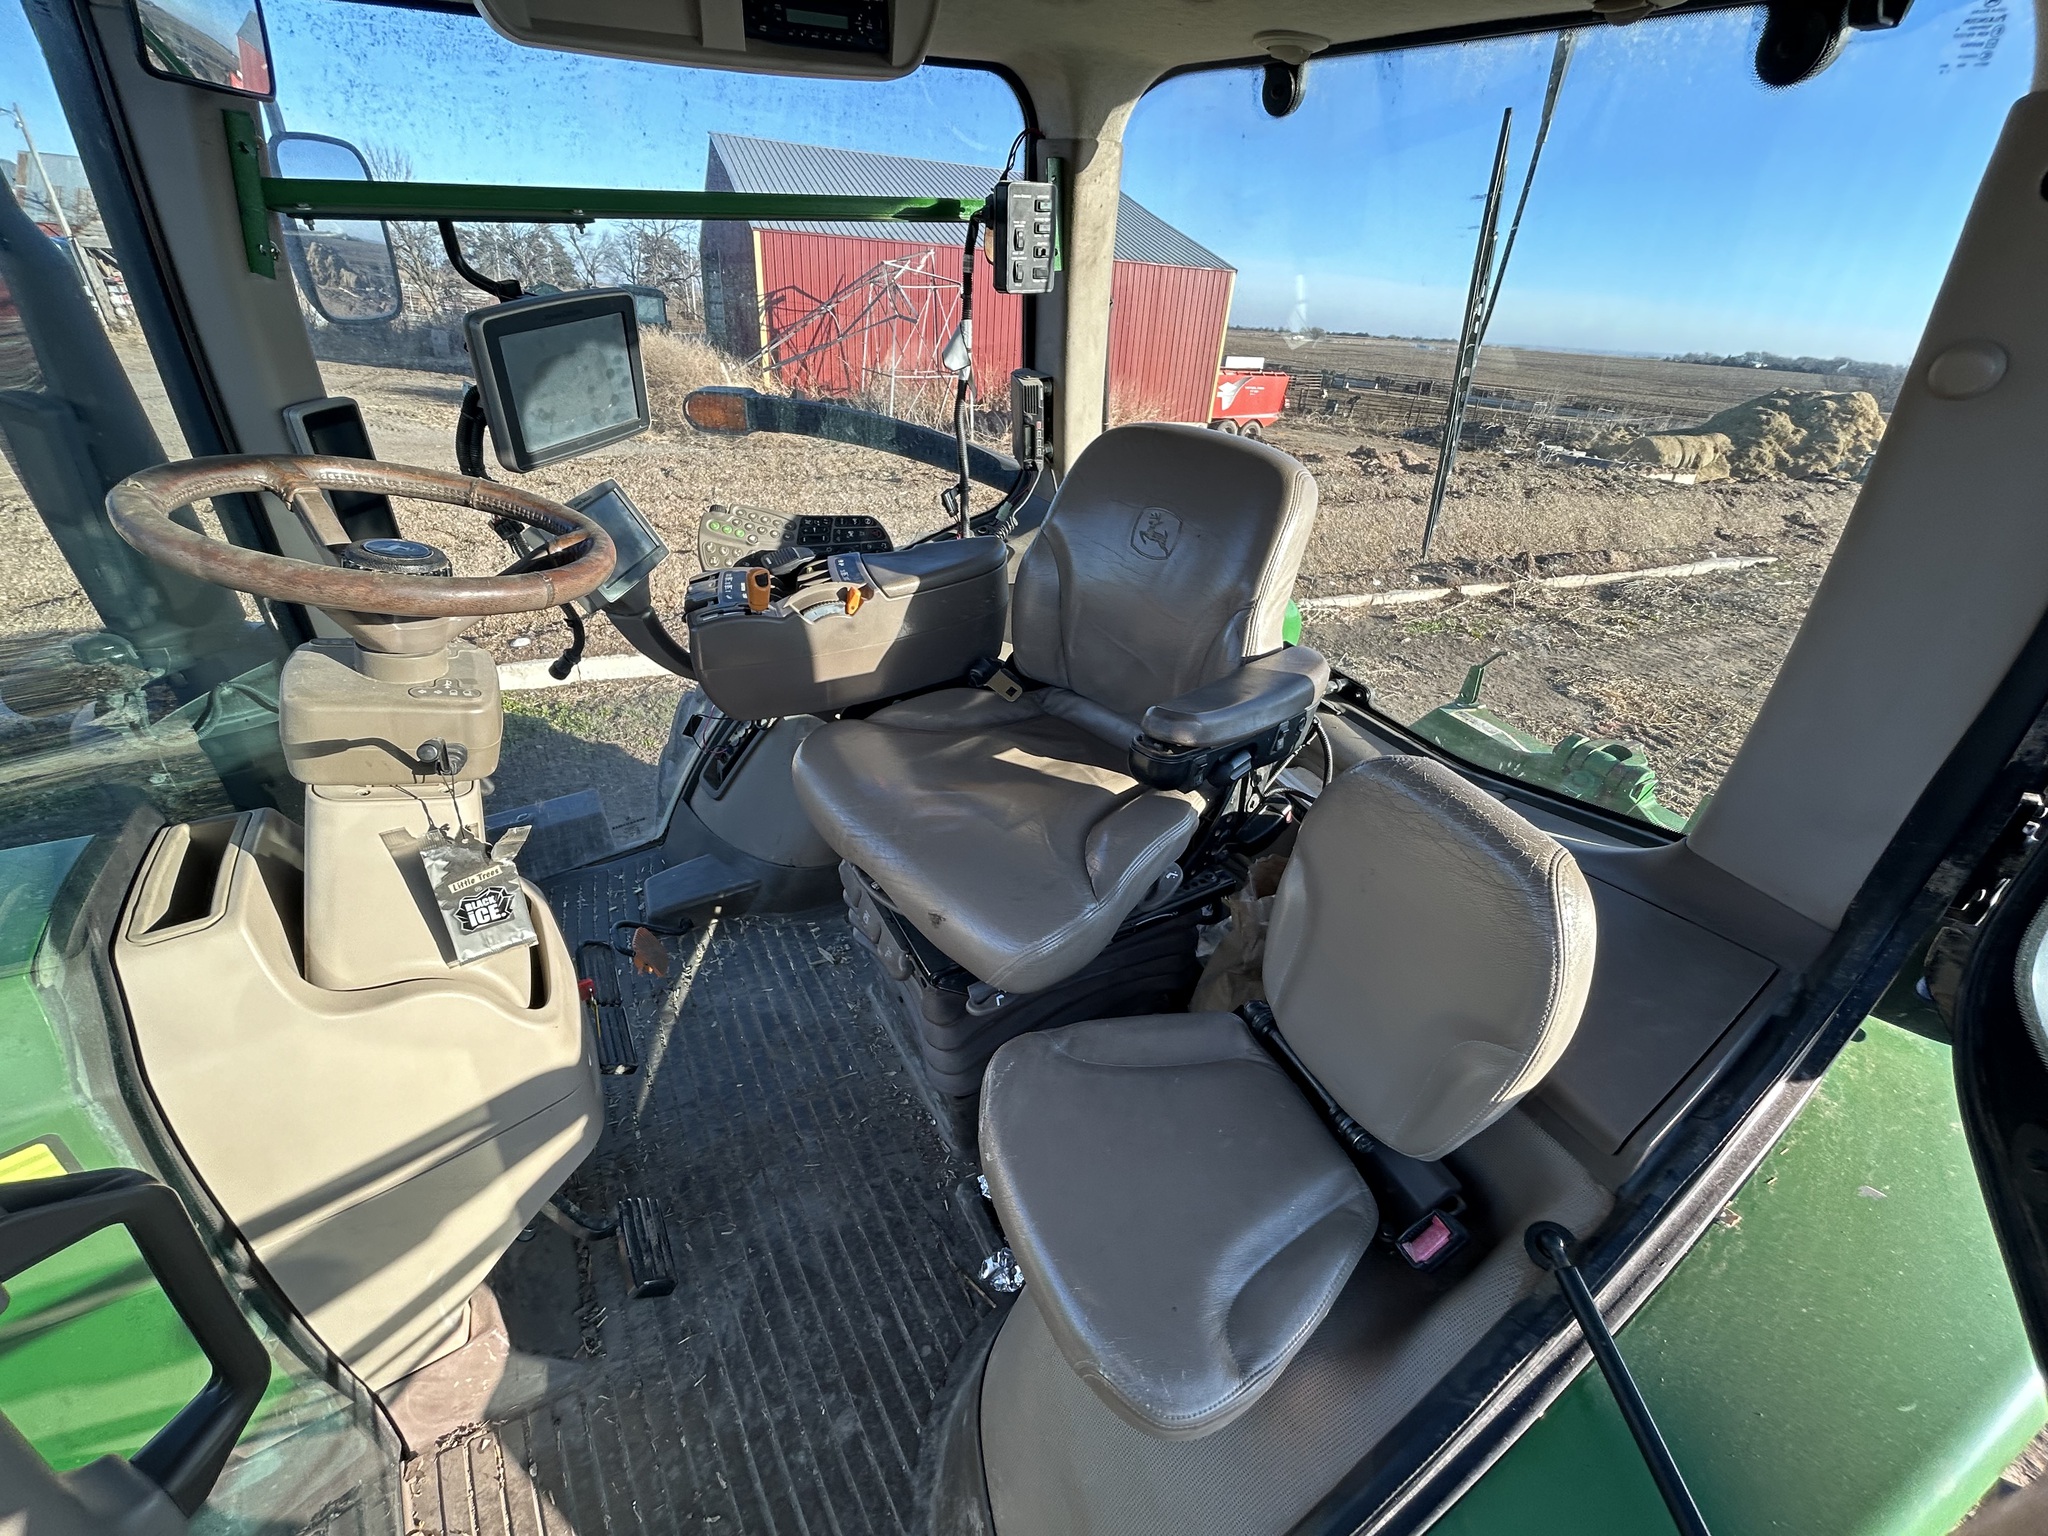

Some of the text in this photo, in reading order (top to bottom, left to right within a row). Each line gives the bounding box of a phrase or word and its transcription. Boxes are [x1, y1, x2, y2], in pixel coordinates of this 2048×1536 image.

[452, 868, 500, 891] Little Trees
[464, 895, 497, 912] BLACK
